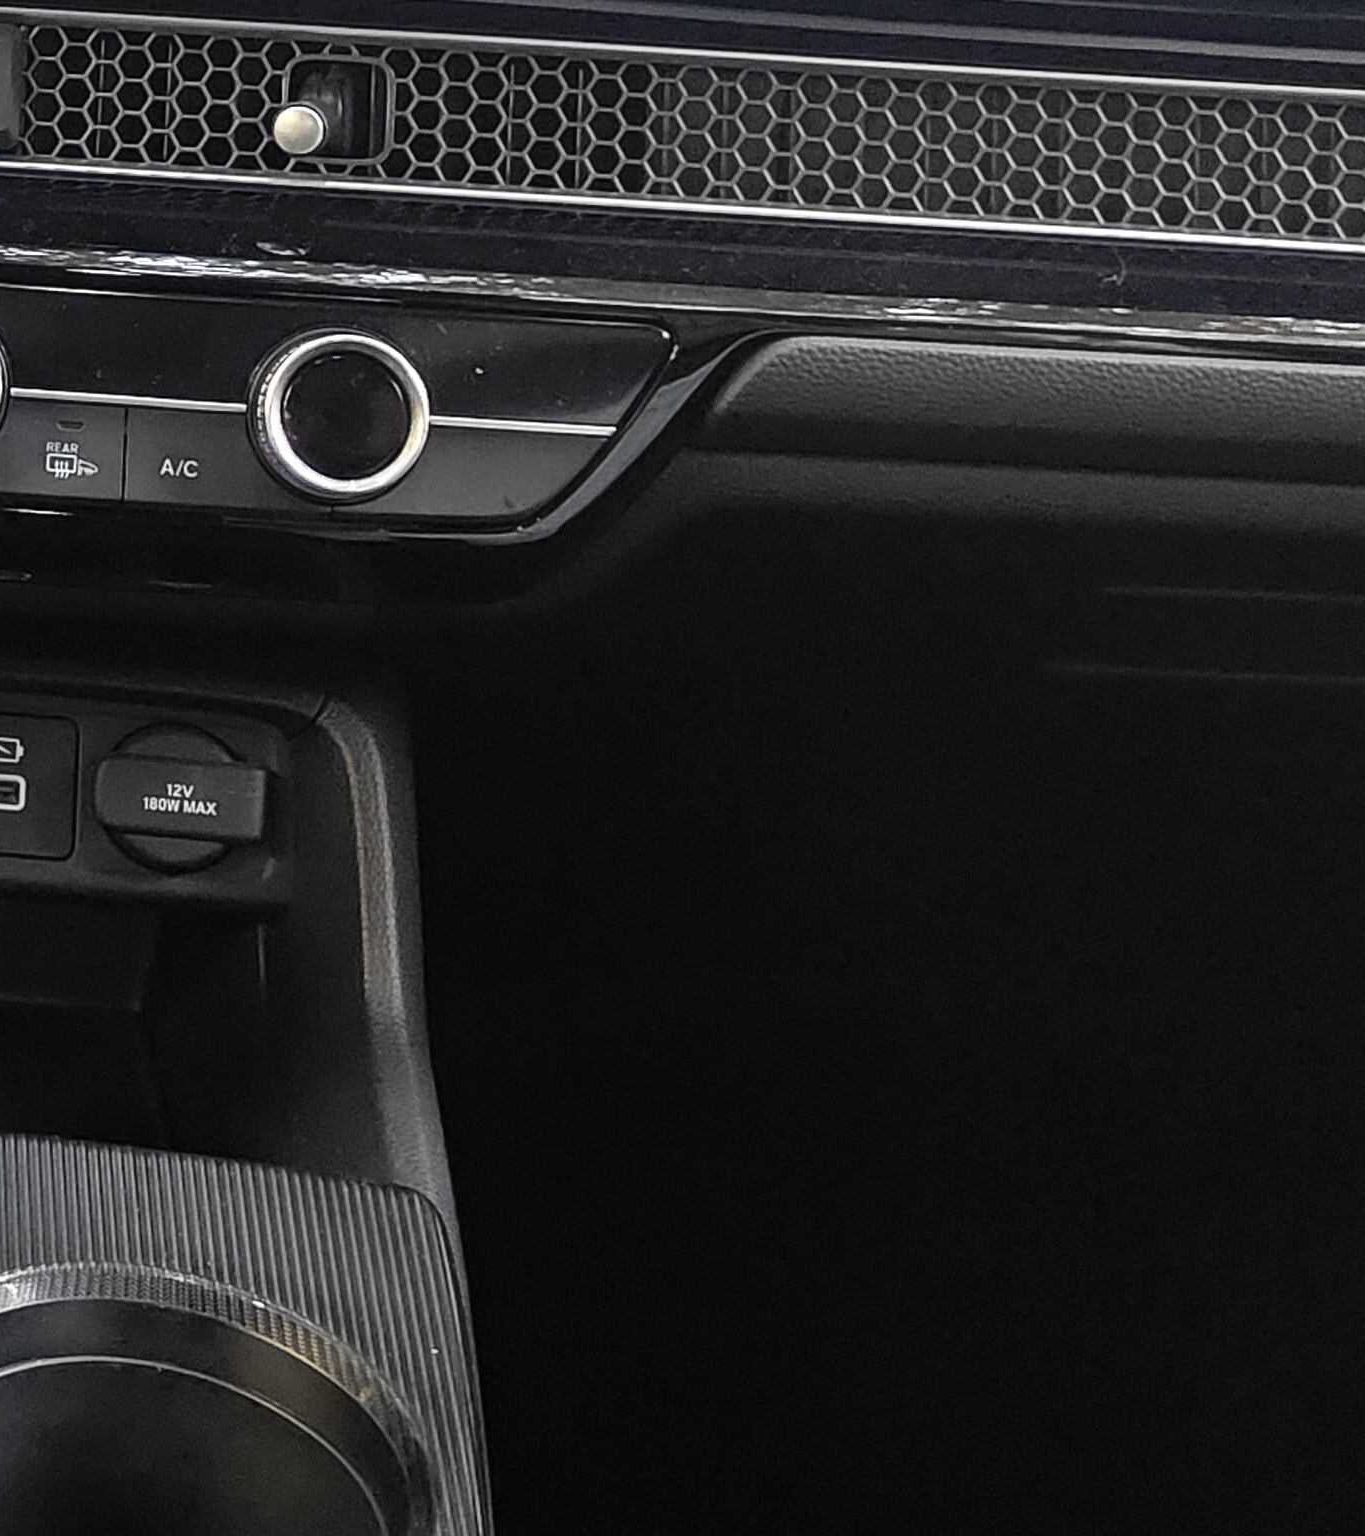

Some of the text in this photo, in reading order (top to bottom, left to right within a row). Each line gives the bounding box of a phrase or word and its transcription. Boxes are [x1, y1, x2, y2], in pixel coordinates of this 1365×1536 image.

[46, 441, 80, 455] REAR
[159, 458, 200, 478] A/C
[166, 783, 195, 799] 12V
[142, 795, 218, 817] 180W MAX
